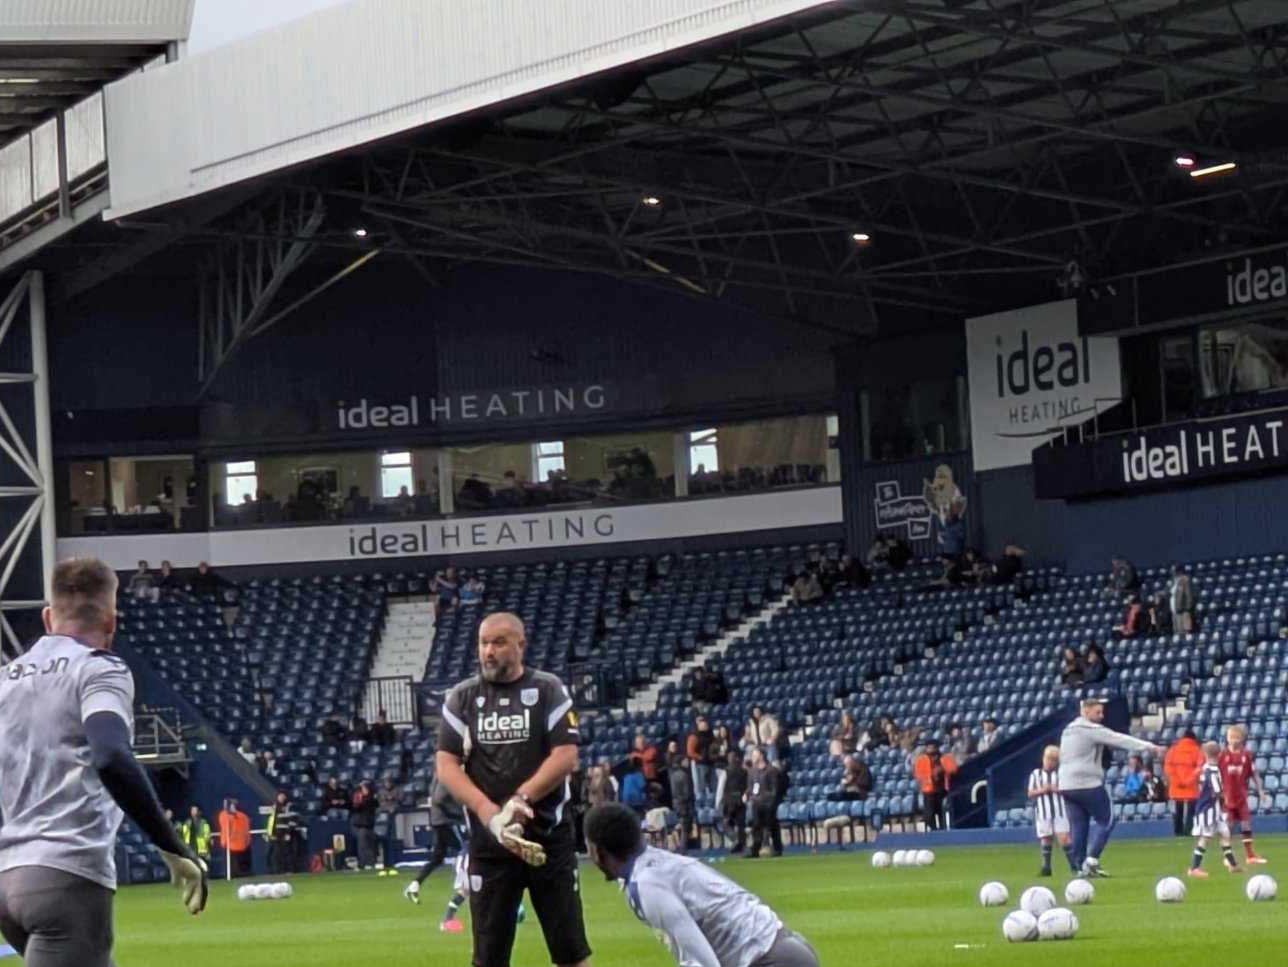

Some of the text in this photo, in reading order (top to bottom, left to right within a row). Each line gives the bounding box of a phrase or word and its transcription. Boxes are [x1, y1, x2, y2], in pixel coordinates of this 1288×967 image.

[1226, 255, 1288, 305] idea
[995, 329, 1091, 398] ideal
[338, 385, 606, 430] ideal HEATING
[1008, 397, 1082, 425] HEATING
[1122, 430, 1189, 483] ideal
[348, 514, 615, 556] ideal HEATING
[477, 708, 531, 732] ideal
[477, 730, 531, 740] HEATING
